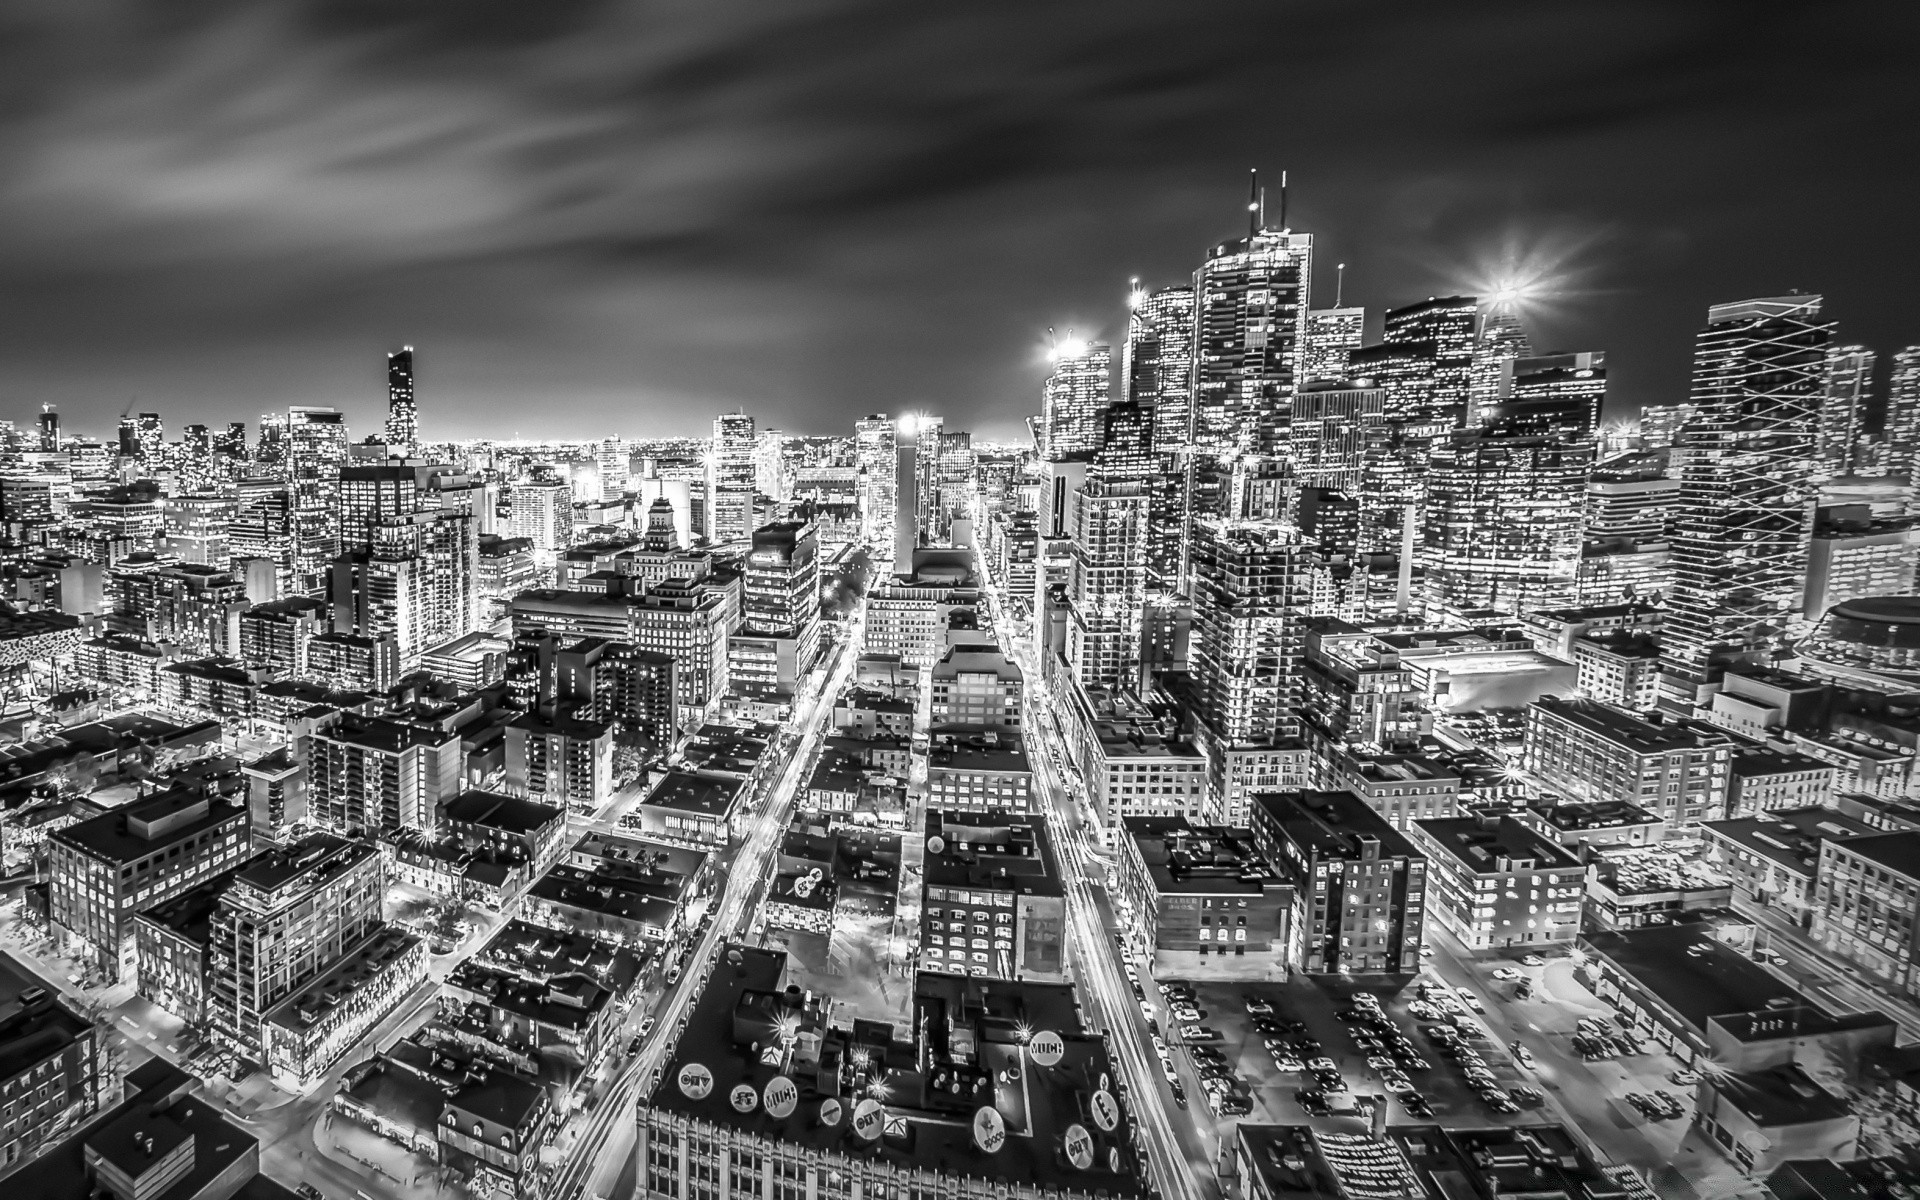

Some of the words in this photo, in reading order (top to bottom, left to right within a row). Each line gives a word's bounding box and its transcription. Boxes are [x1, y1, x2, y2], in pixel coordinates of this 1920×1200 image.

[1031, 1042, 1062, 1054] MUCH
[681, 1074, 710, 1088] CTV
[766, 1086, 796, 1109] MUCH
[857, 1109, 880, 1130] CTV
[984, 1131, 1005, 1149] space
[1068, 1137, 1088, 1157] CTV
